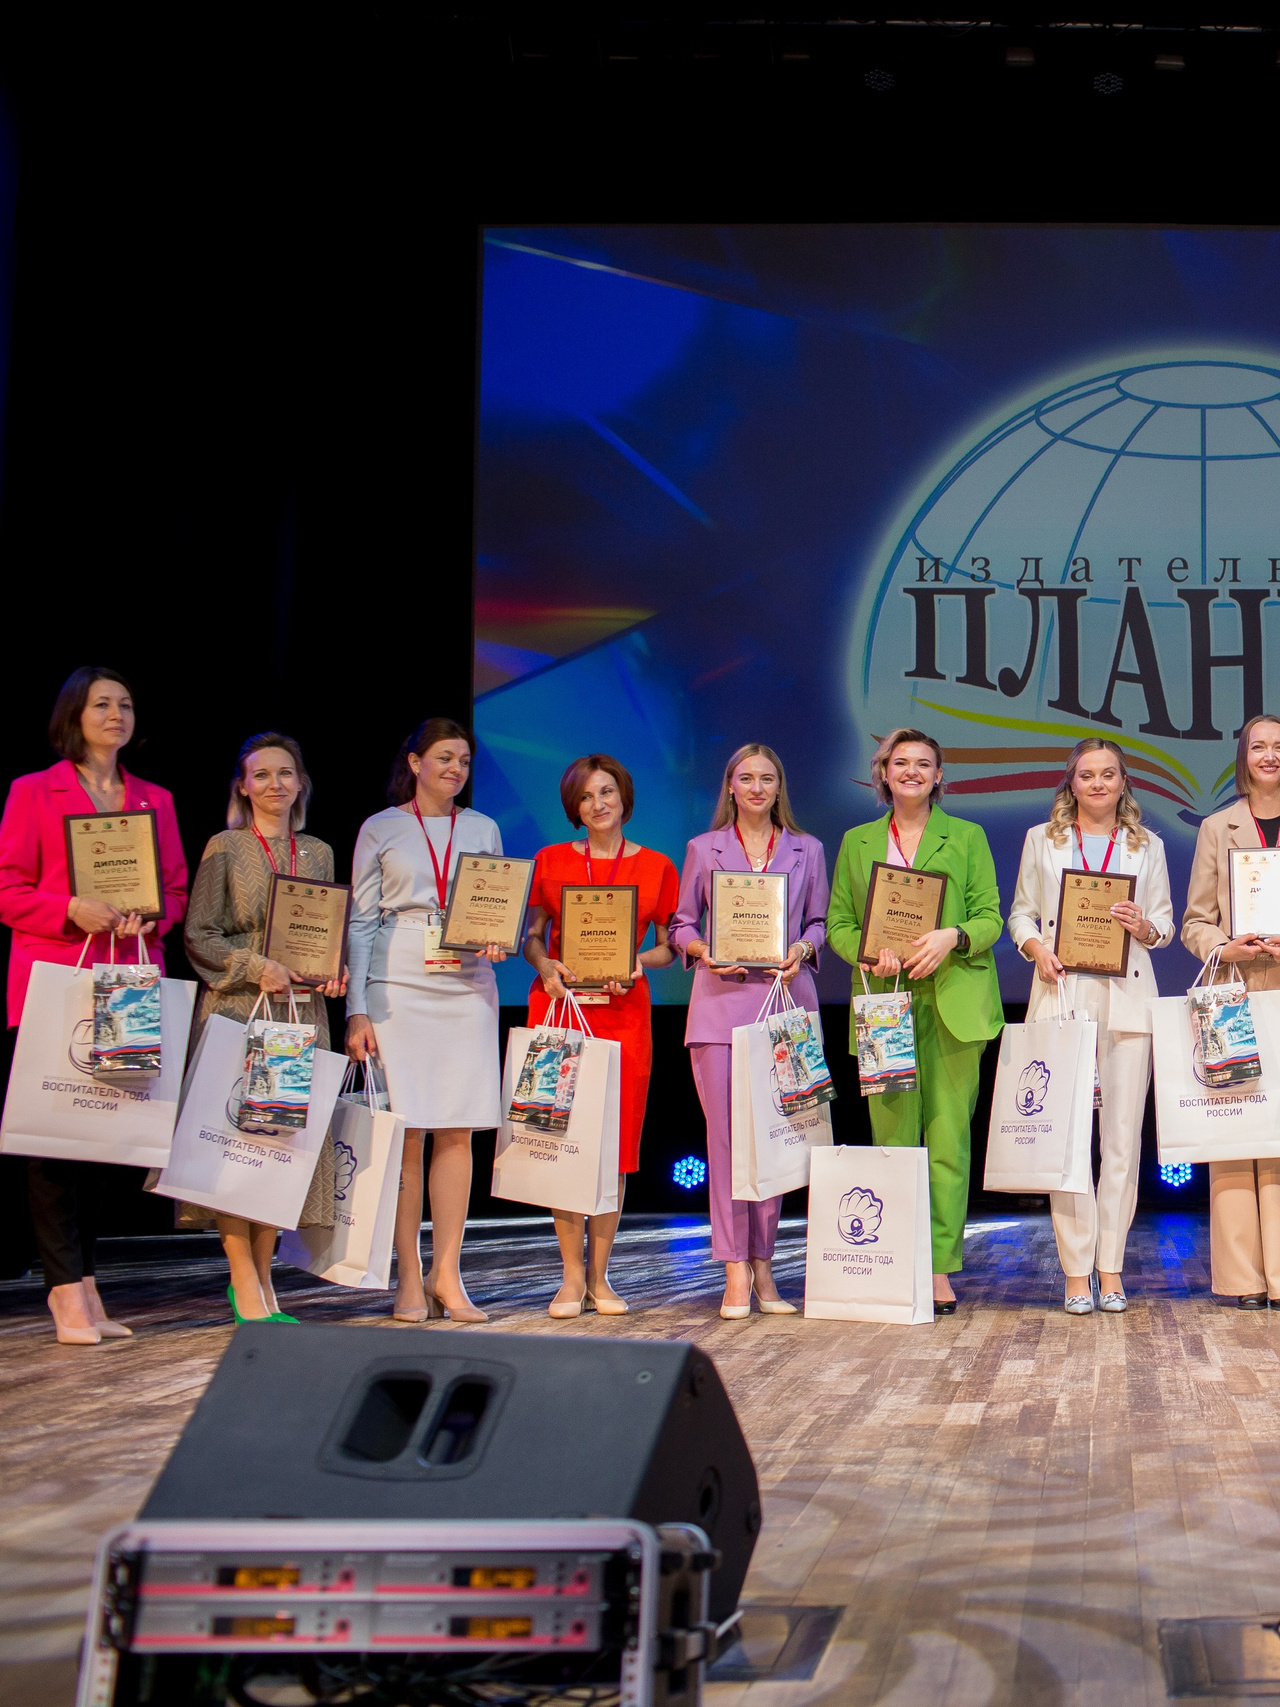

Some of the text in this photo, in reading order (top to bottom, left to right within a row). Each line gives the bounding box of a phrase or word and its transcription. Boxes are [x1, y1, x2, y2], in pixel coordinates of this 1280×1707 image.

[93, 859, 137, 869] ДИПЛОМ
[94, 866, 138, 875] ЛАУРЕАТА
[470, 895, 508, 904] ДИПЛОМ
[469, 902, 506, 910] ЛАУРЕАТА
[886, 909, 922, 921] ДИПЛОМ
[1076, 915, 1112, 924] ДИПЛОМ
[885, 916, 921, 927] ЛАУРЕАТА
[1076, 922, 1111, 931] ЛАУРЕАТА
[289, 922, 328, 934] ДИПЛОМ
[288, 930, 327, 940] ЛАУРЕАТА
[42, 1081, 121, 1098] ВОСПИТАТЕЛЬ
[122, 1090, 150, 1102] ГОДА
[72, 1098, 118, 1111] РОССИИ
[1179, 1094, 1268, 1108] ВОСПИТАТЕЛЬ ГОДА
[1206, 1108, 1243, 1118] РОССИИ
[769, 1121, 805, 1140] ВОСПИТАТЕЛЬ
[804, 1117, 820, 1128] ГОДА
[1000, 1124, 1053, 1134] ВОСПИТАТЕЛЬ ГОДА
[511, 1134, 580, 1154] ВОСПИТАТЕЛЬ ГОДА
[784, 1133, 807, 1146] РОССИИ
[1014, 1137, 1036, 1145] РОССИИ
[199, 1129, 267, 1156] ВОСПИТАТЕЛЬ
[268, 1149, 292, 1163] ГОДА
[222, 1150, 263, 1169] РОССИИ
[529, 1150, 558, 1162] РОССИИ
[822, 1252, 894, 1265] ВОСПИТАТЕЛЬ ГОДА
[842, 1266, 873, 1275] РОССИИ
